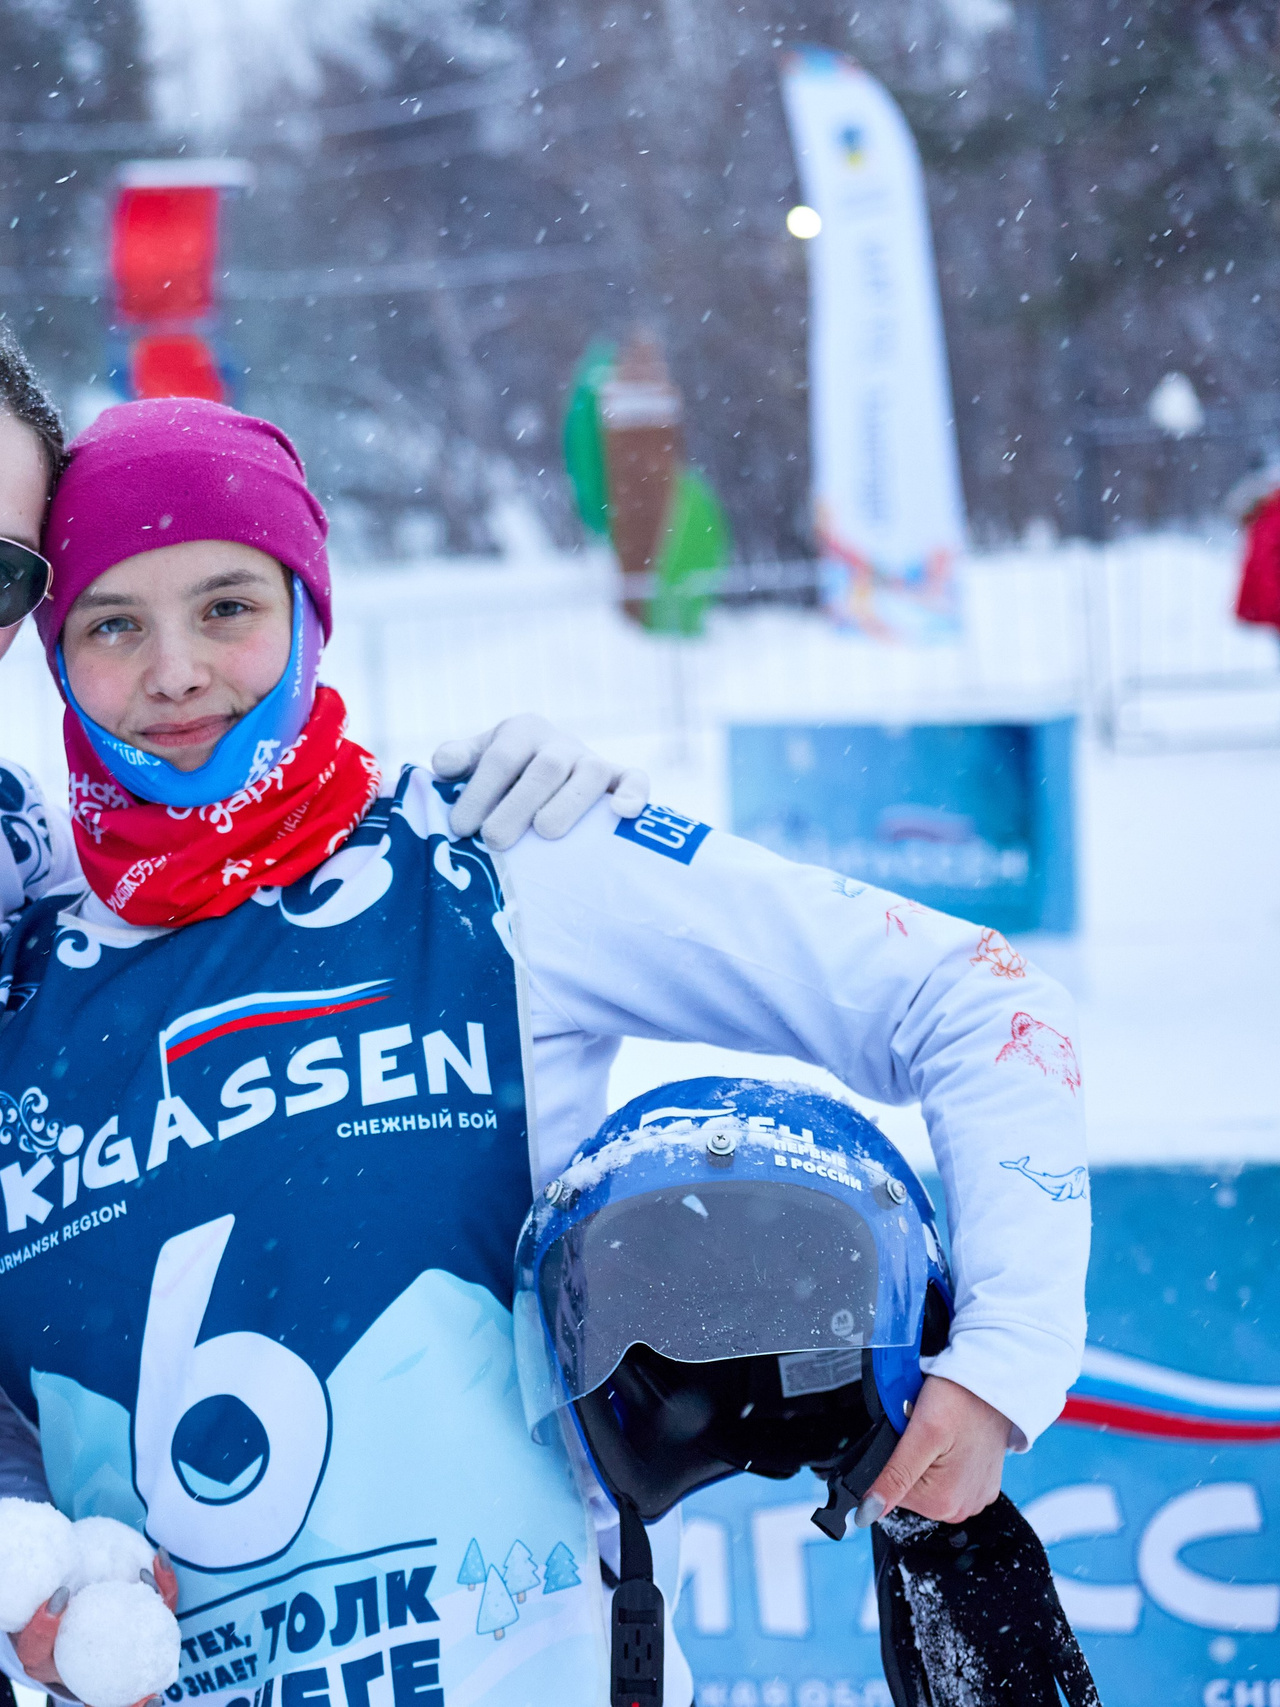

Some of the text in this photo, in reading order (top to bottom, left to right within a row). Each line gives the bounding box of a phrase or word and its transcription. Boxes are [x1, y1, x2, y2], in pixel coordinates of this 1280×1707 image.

[336, 1109, 498, 1138] СНЕЖНЫЙ БОЙ
[774, 1138, 848, 1169] ПЕРВЫЕ
[774, 1154, 863, 1191] В РОССИИ
[63, 1200, 128, 1242] REGION
[133, 1213, 331, 1571] 6
[181, 1565, 441, 1668] ТЕХ, ТОЛК
[183, 1653, 258, 1698] ЗНАЕТ
